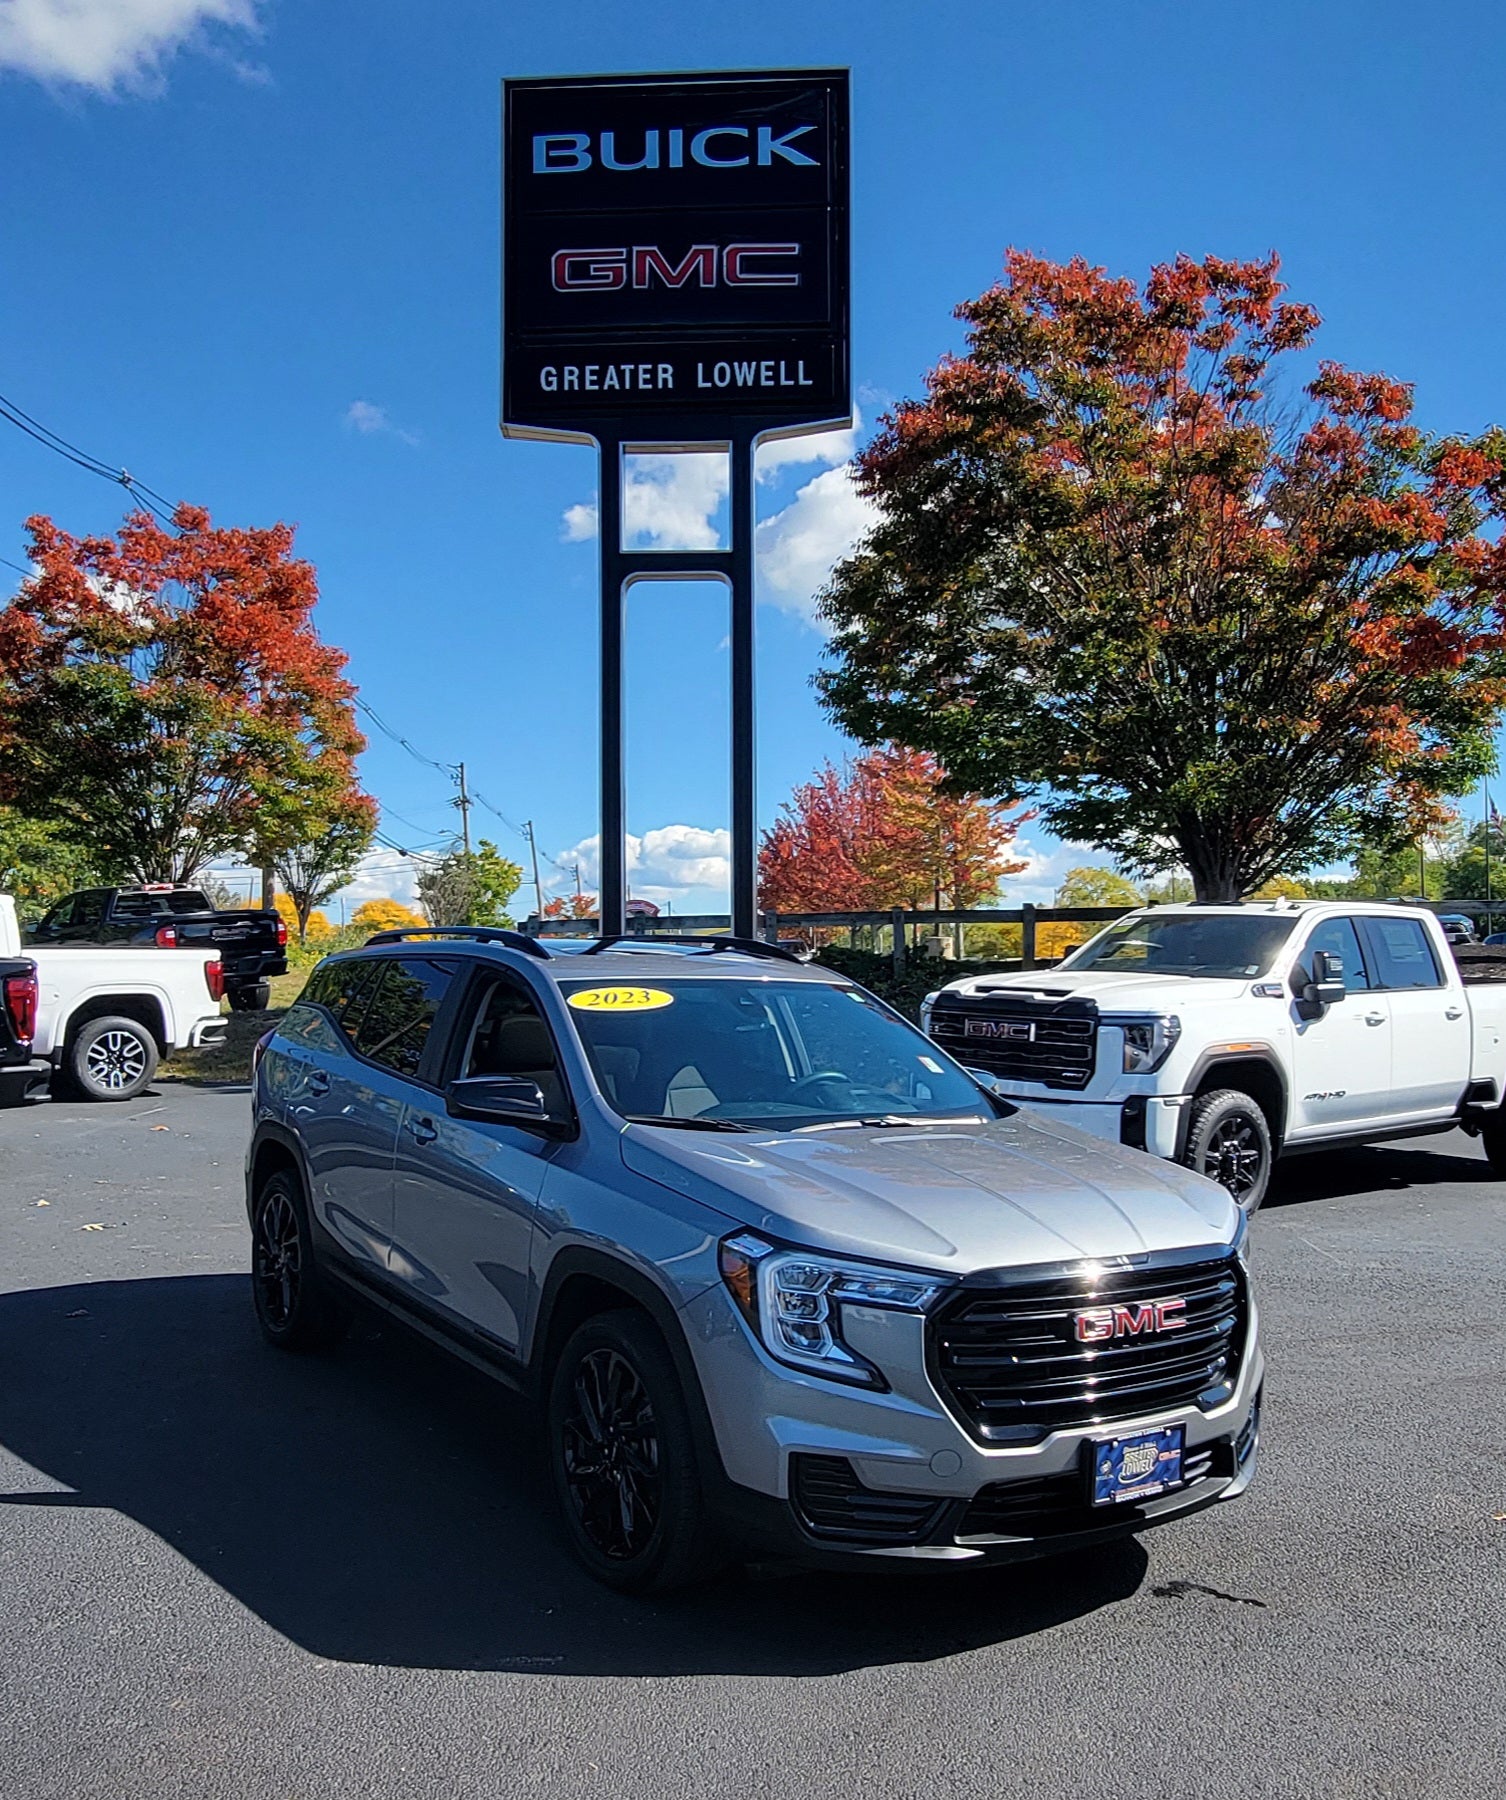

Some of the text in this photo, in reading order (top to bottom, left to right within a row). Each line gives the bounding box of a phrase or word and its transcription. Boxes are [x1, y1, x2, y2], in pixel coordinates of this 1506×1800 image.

[532, 125, 821, 174] BUICK
[551, 243, 801, 293] GMC
[540, 360, 813, 392] GREATER LOWELL
[586, 990, 651, 1007] 2023
[967, 1020, 1030, 1039] GMC
[1075, 1298, 1187, 1342] GMC
